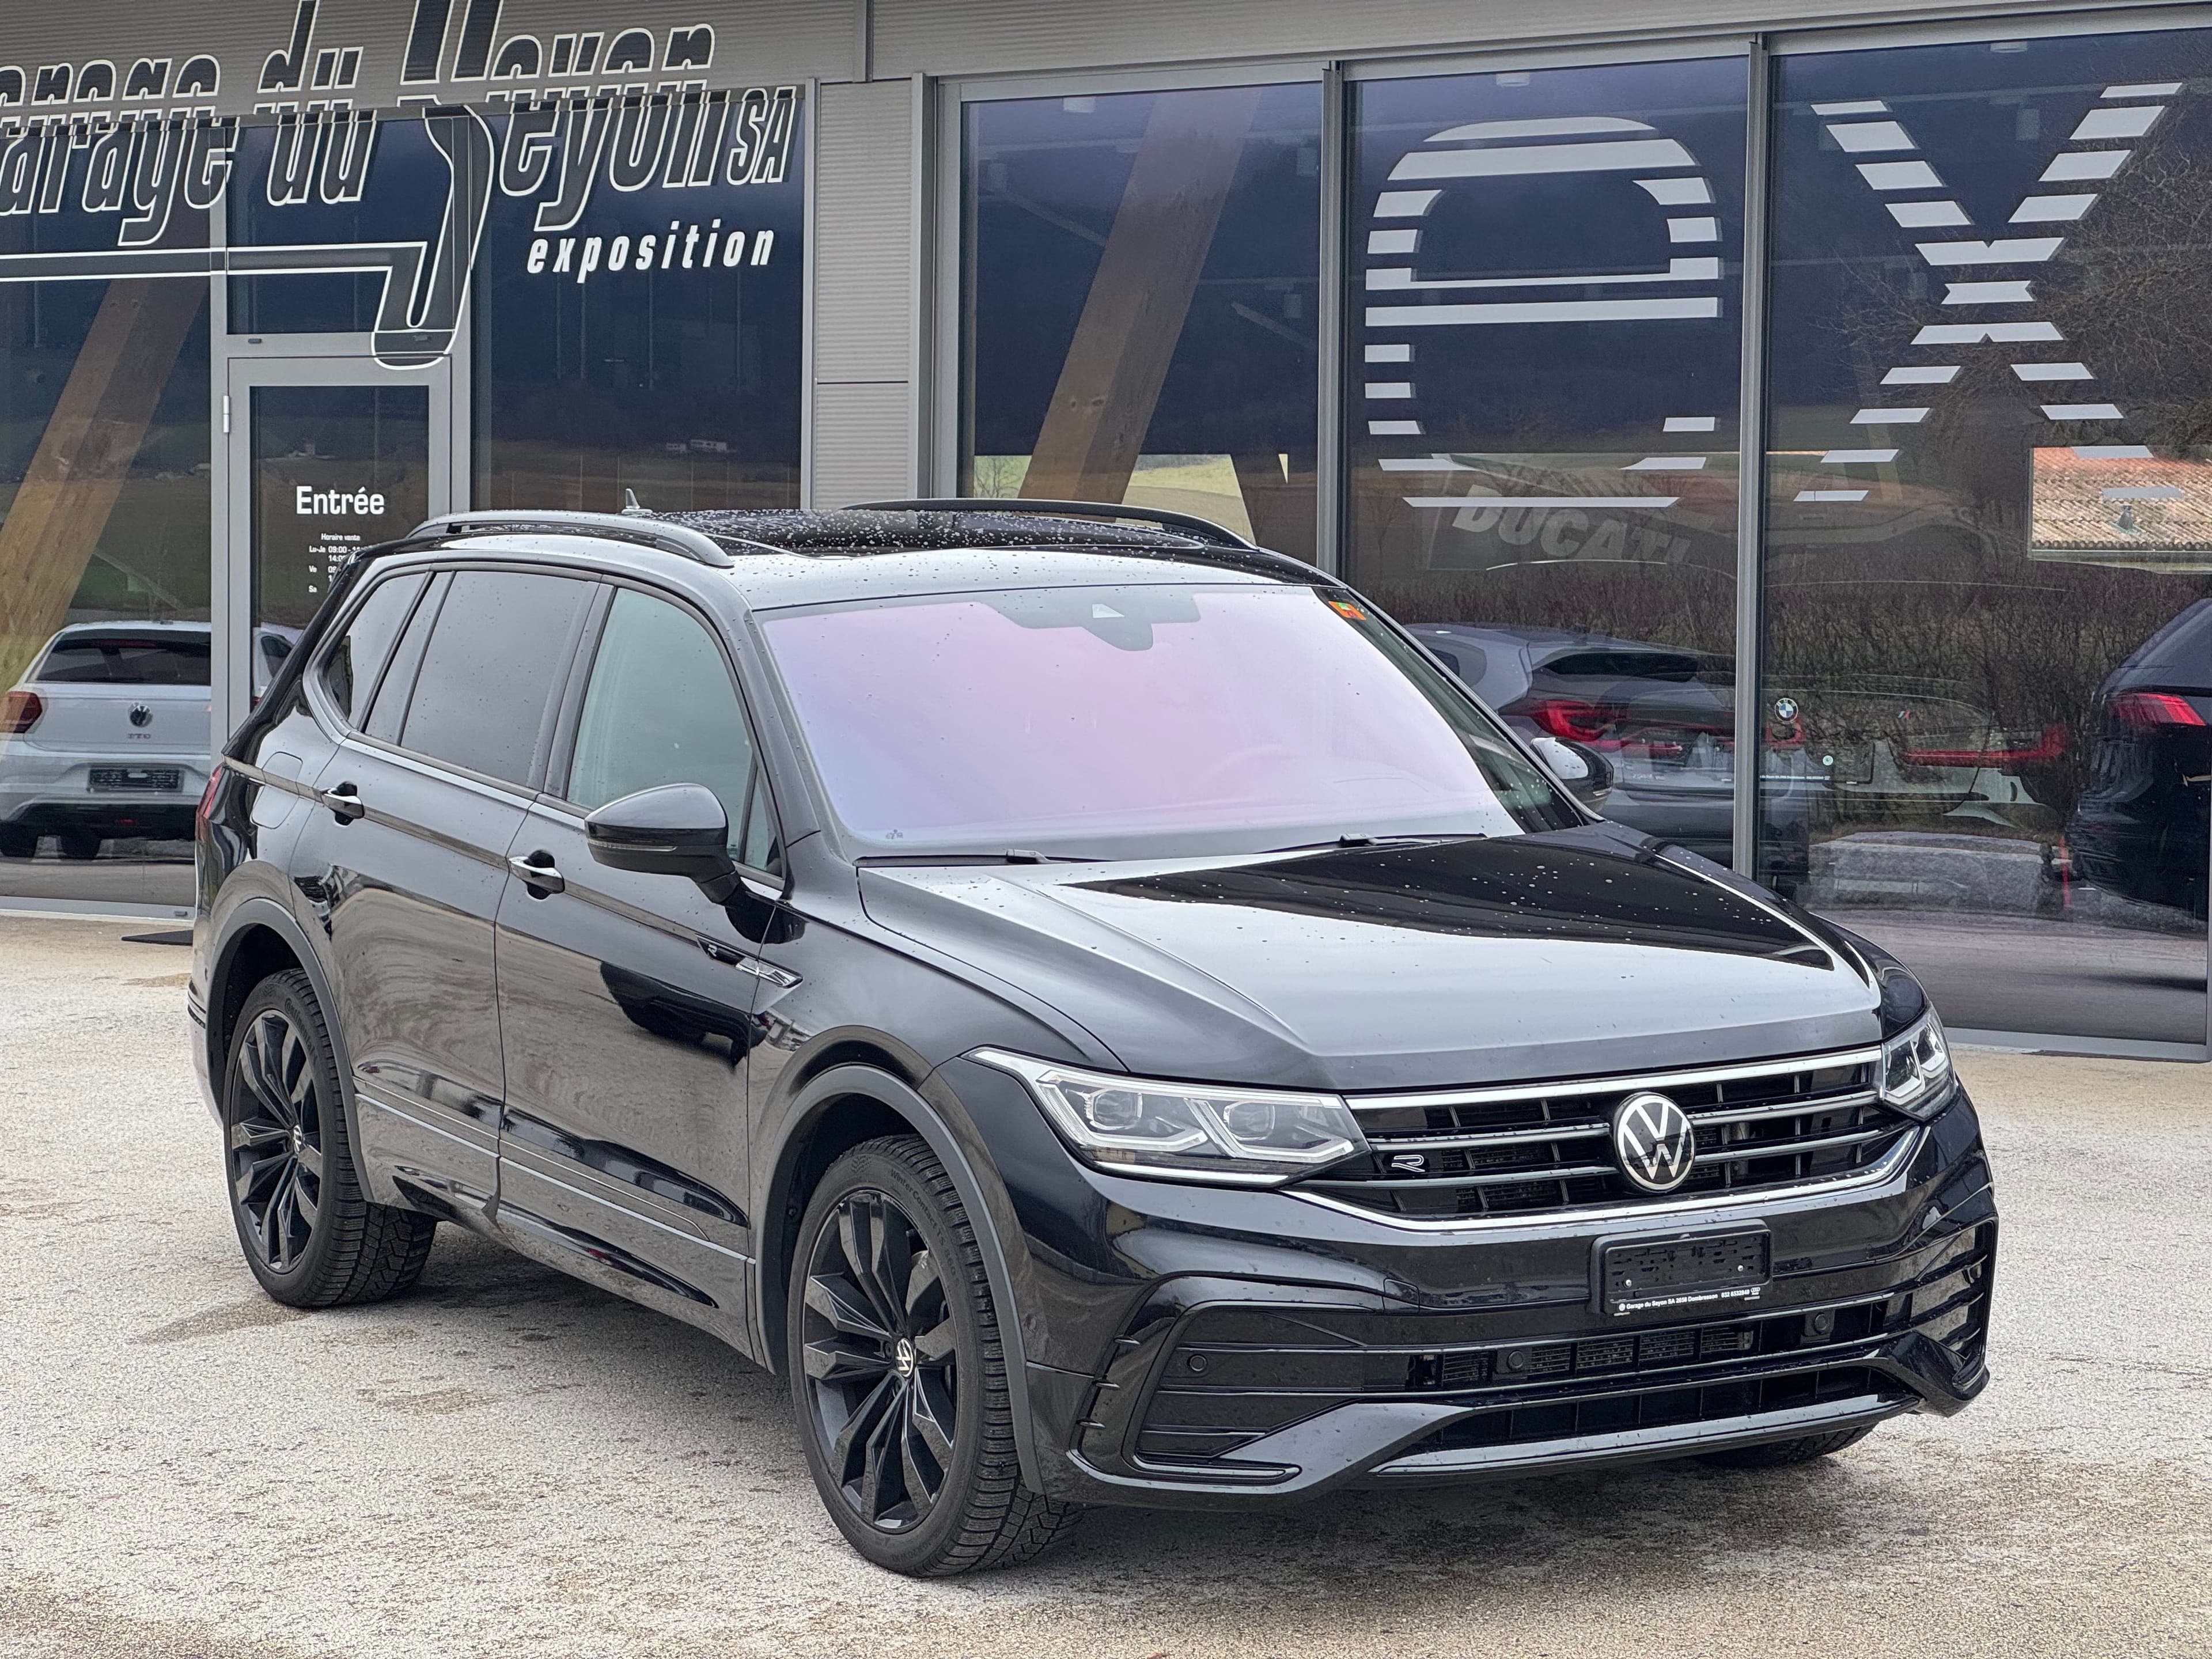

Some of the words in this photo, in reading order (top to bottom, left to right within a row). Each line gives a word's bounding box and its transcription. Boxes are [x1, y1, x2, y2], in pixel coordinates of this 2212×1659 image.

[726, 86, 797, 185] SA
[527, 219, 774, 283] exposition
[296, 486, 385, 515] Entrée
[1452, 483, 1691, 562] DUCATI
[1391, 1154, 1426, 1172] R
